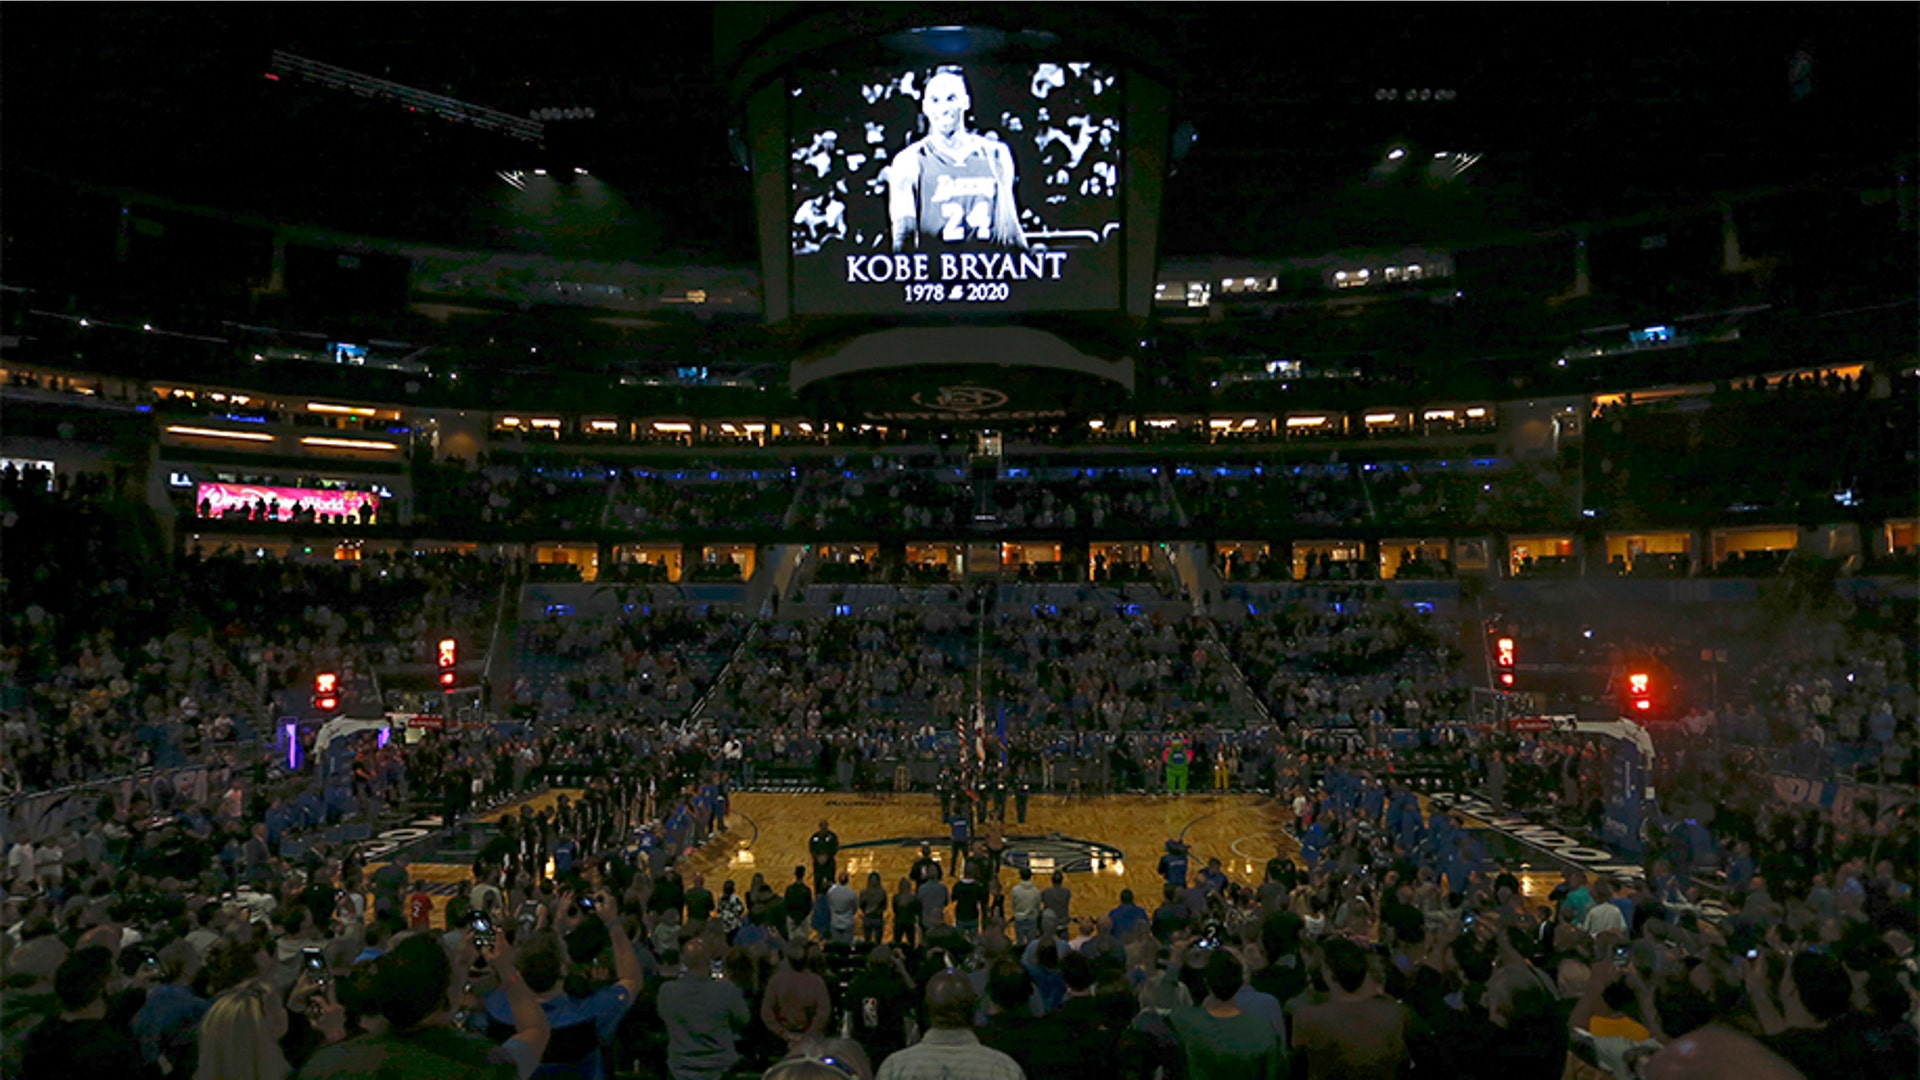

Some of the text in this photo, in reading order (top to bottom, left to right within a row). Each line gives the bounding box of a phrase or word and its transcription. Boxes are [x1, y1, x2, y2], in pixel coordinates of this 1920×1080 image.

[941, 201, 991, 241] 24
[846, 251, 1067, 282] KOBE BRYANT
[904, 283, 1009, 302] 1978 2020
